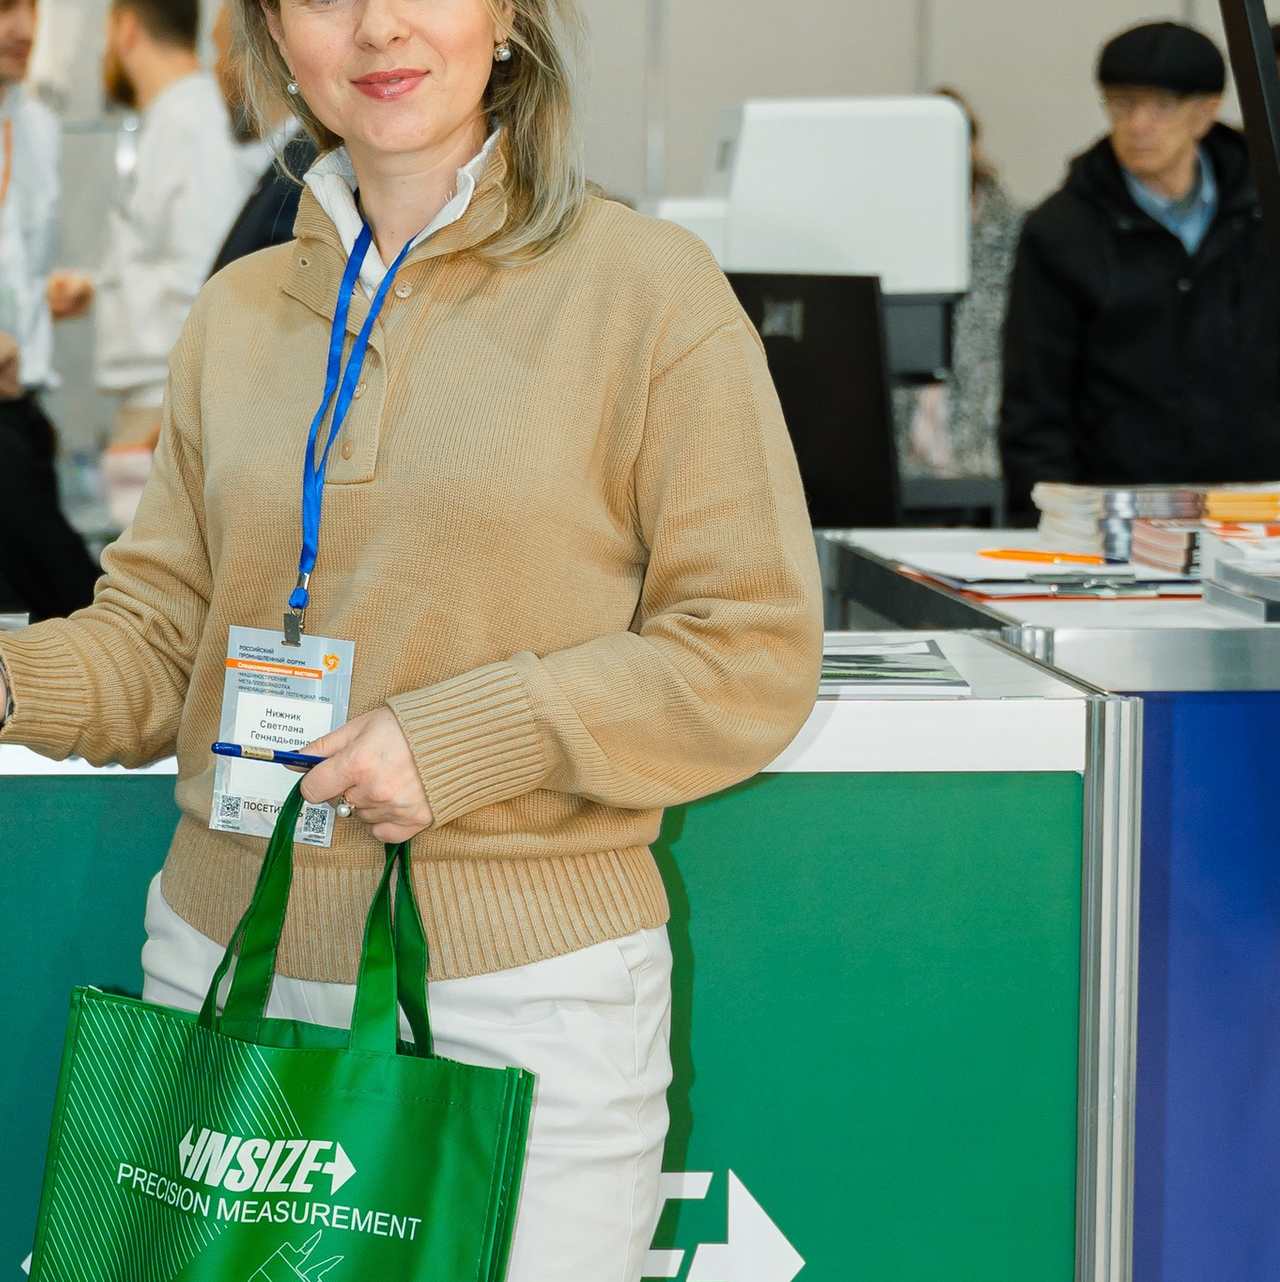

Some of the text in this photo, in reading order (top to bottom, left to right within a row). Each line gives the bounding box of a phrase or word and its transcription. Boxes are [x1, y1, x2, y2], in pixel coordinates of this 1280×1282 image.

[239, 645, 274, 654] РОССИЙСКИЙ
[286, 658, 306, 666] ФОРУМ
[265, 708, 302, 721] Нижник
[260, 720, 304, 734] Светлана
[183, 1128, 334, 1193] INSIZE
[116, 1163, 211, 1217] PRECISION
[217, 1197, 422, 1241] MEASUREMENT
